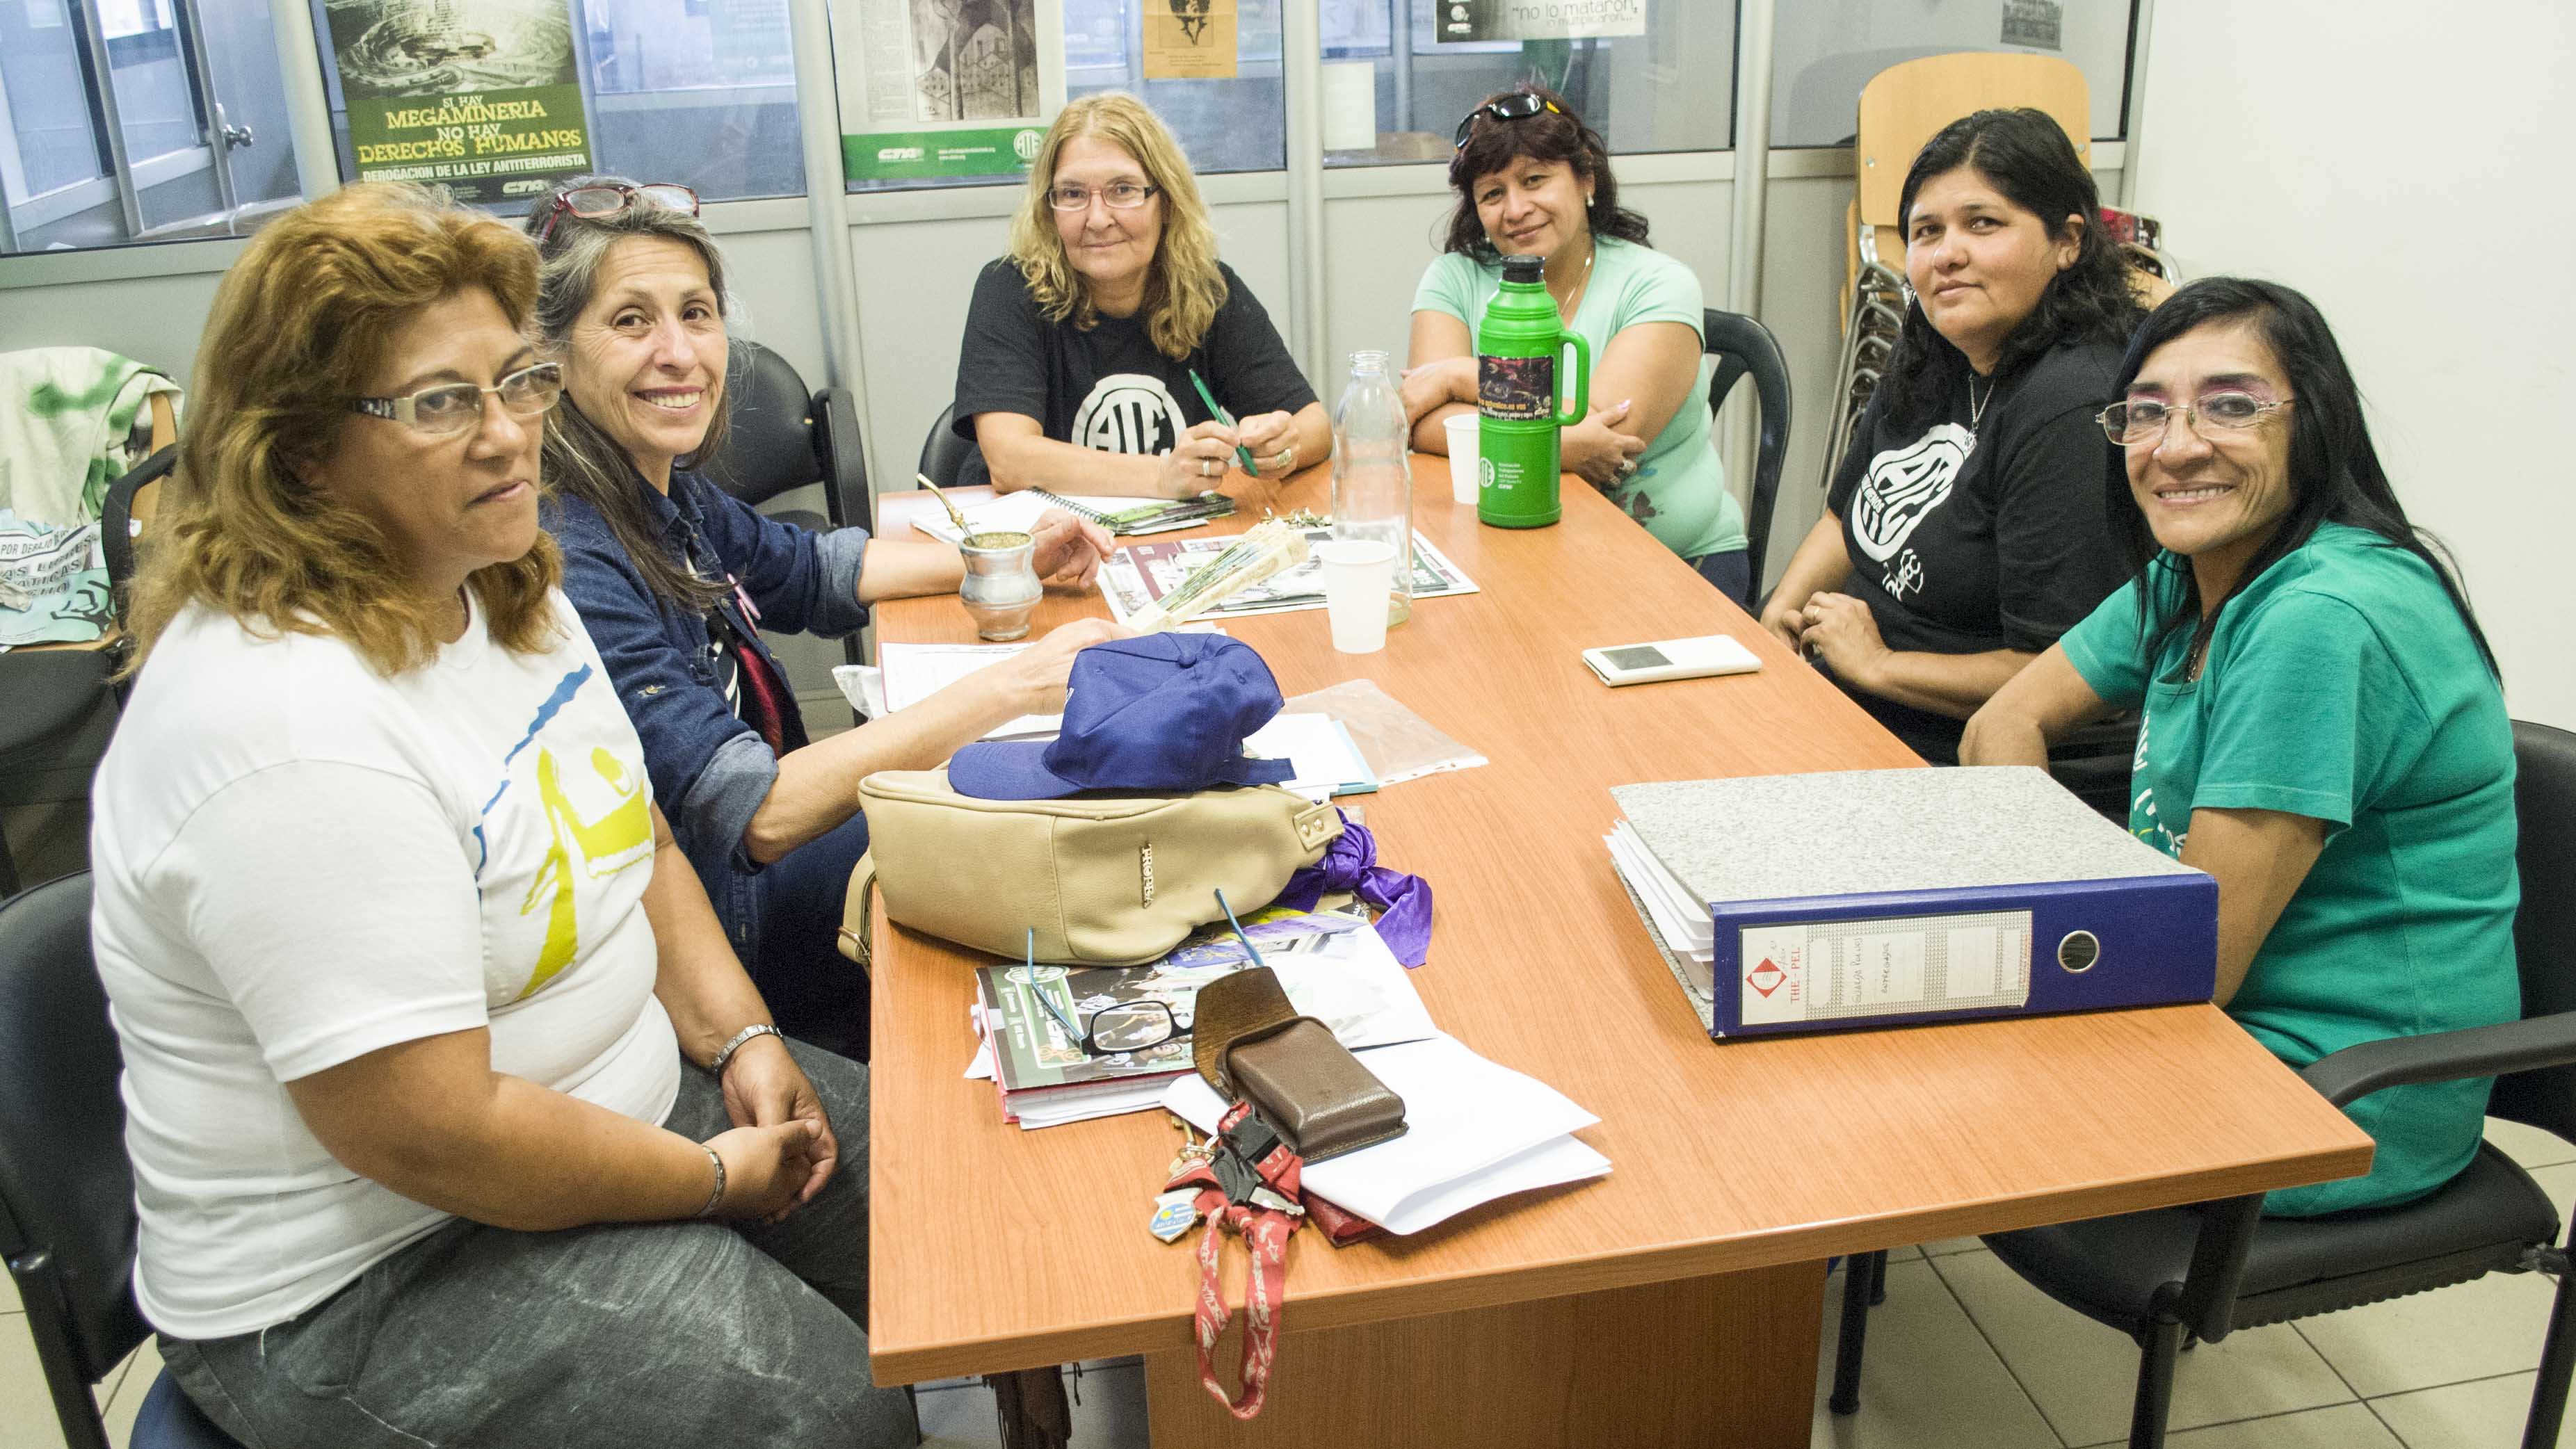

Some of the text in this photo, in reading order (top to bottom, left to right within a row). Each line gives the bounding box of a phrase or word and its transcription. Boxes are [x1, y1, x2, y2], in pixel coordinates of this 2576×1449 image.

[1545, 3, 1559, 18] lo
[442, 95, 483, 108] SI HAY
[385, 100, 547, 129] MEGAMINERIA
[436, 123, 501, 140] NO HAY
[357, 129, 583, 163] DERECHOS HUMANOS
[362, 153, 587, 184] DEROGACION DE LA LEY ANTITERRORISTA
[1086, 388, 1175, 456] ATE
[1, 543, 18, 555] POR
[1791, 946, 1801, 970] PEL
[1790, 985, 1800, 1004] THE
